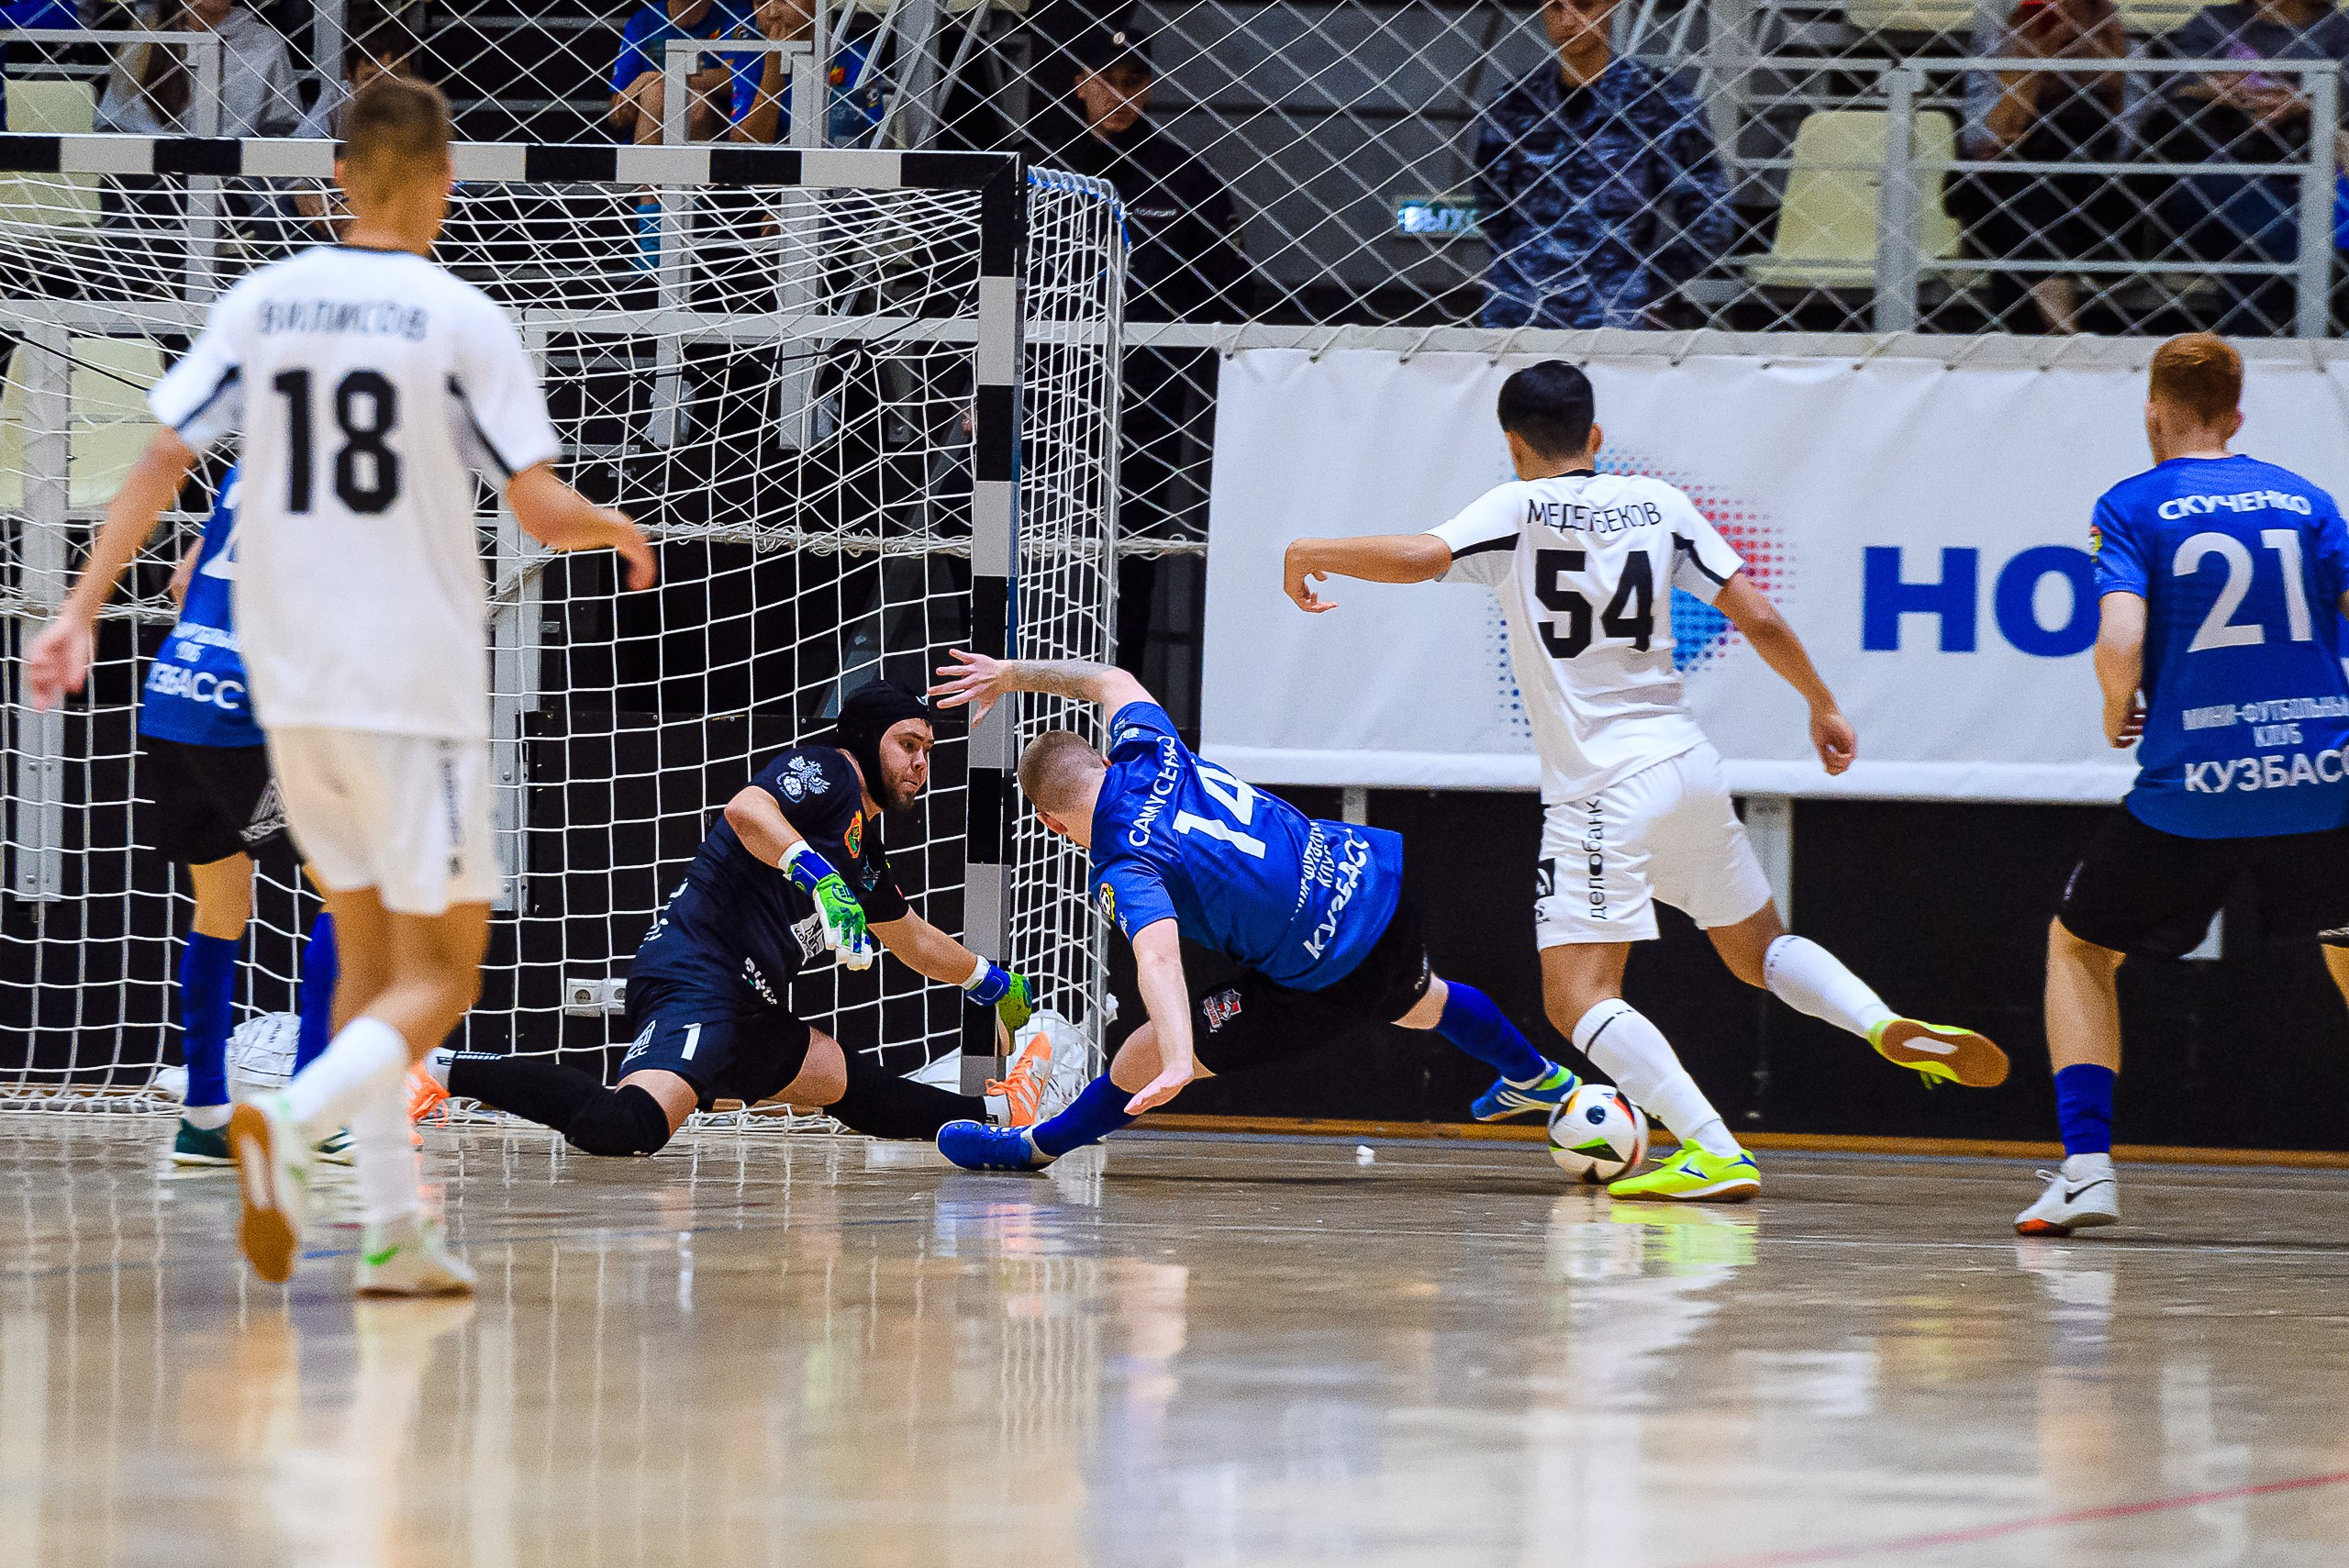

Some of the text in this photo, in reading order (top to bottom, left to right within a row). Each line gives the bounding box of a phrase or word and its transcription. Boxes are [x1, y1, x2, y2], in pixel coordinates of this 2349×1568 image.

[273, 369, 398, 513] 18
[2157, 489, 2312, 521] СКУЧЕНКО
[1534, 549, 1654, 660] 54
[2172, 528, 2313, 653] 21
[1172, 759, 1271, 860] 14
[682, 1022, 703, 1061] 1
